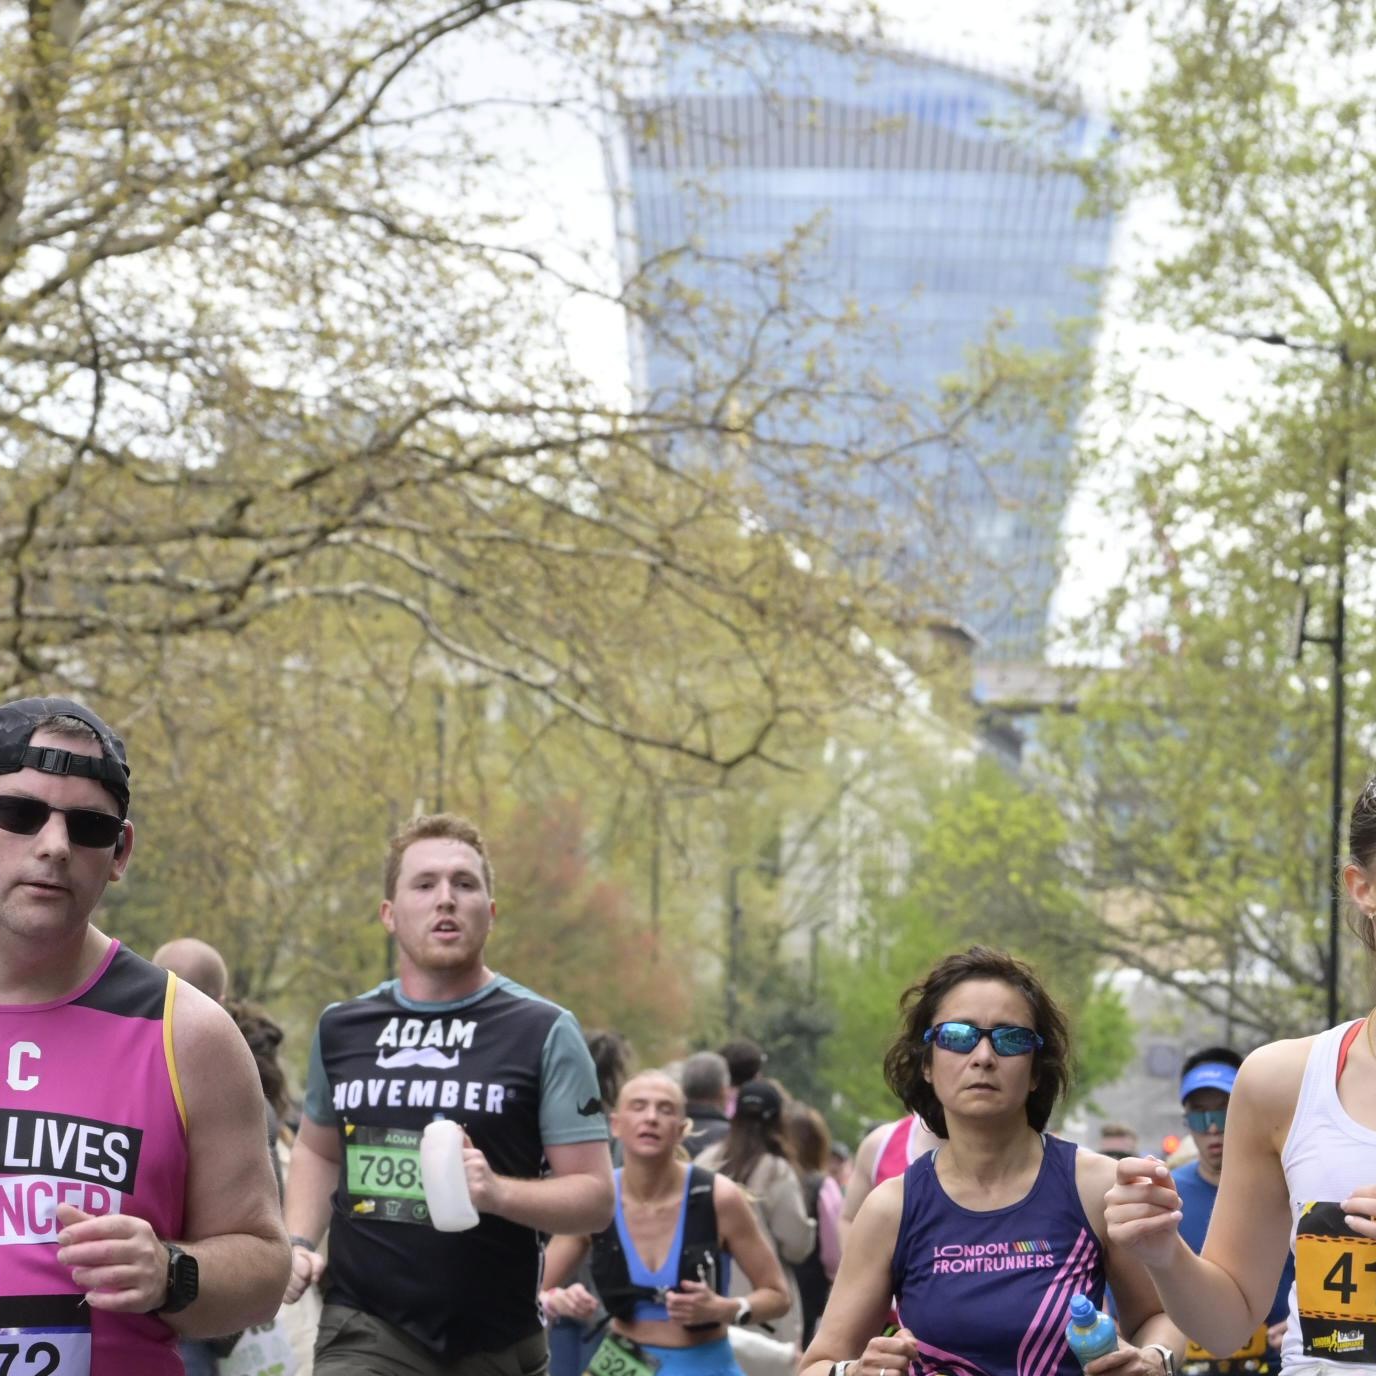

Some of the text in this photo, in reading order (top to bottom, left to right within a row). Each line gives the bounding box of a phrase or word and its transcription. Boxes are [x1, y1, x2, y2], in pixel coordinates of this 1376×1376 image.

[375, 1017, 478, 1049] ADAM
[3, 1117, 130, 1183] LIVES
[384, 1134, 418, 1146] ADAM
[359, 1154, 425, 1191] 798
[933, 1242, 1009, 1258] LONDON
[932, 1254, 1055, 1274] FRONTRUNNERS
